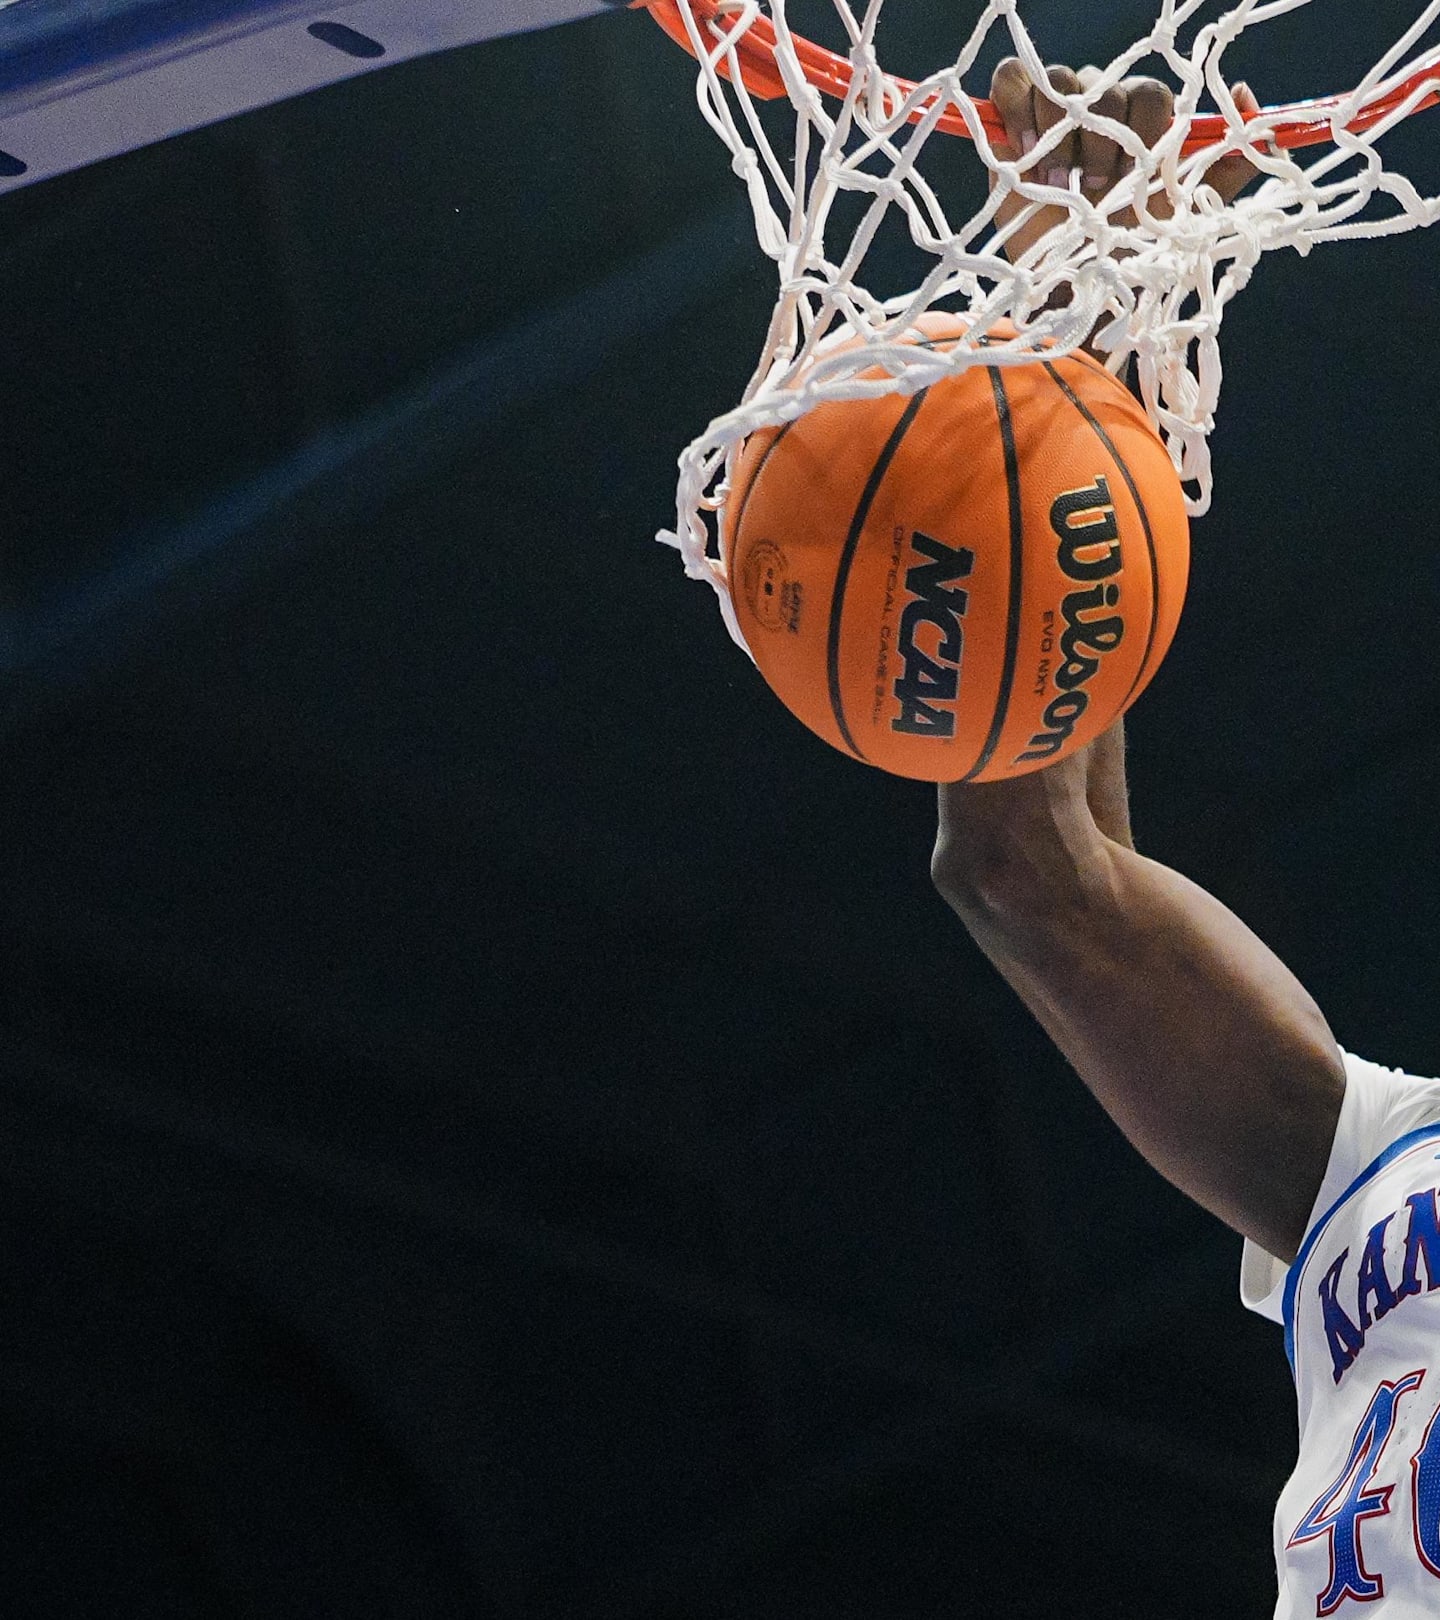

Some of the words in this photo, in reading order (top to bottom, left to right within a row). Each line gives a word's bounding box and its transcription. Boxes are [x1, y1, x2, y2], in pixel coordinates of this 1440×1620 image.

[892, 531, 974, 739] NCAA
[1012, 474, 1125, 765] Wilson
[1033, 658, 1051, 696] NXT
[1041, 610, 1055, 653] EVO
